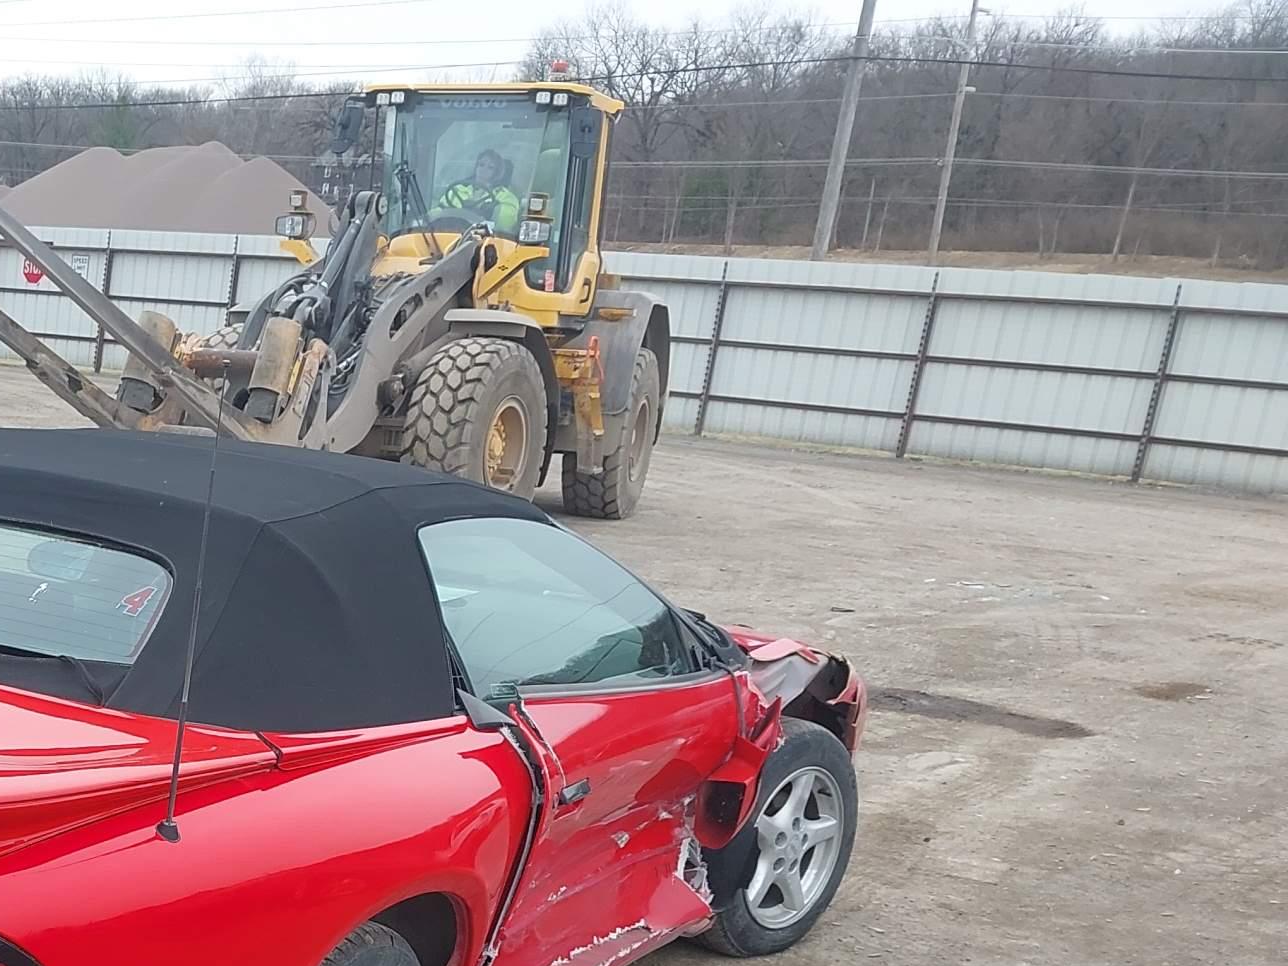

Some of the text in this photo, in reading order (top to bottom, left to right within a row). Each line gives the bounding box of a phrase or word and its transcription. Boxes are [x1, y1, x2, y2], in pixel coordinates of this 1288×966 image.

[440, 98, 507, 109] VOLVO
[24, 260, 42, 274] STO
[121, 586, 158, 617] 4
